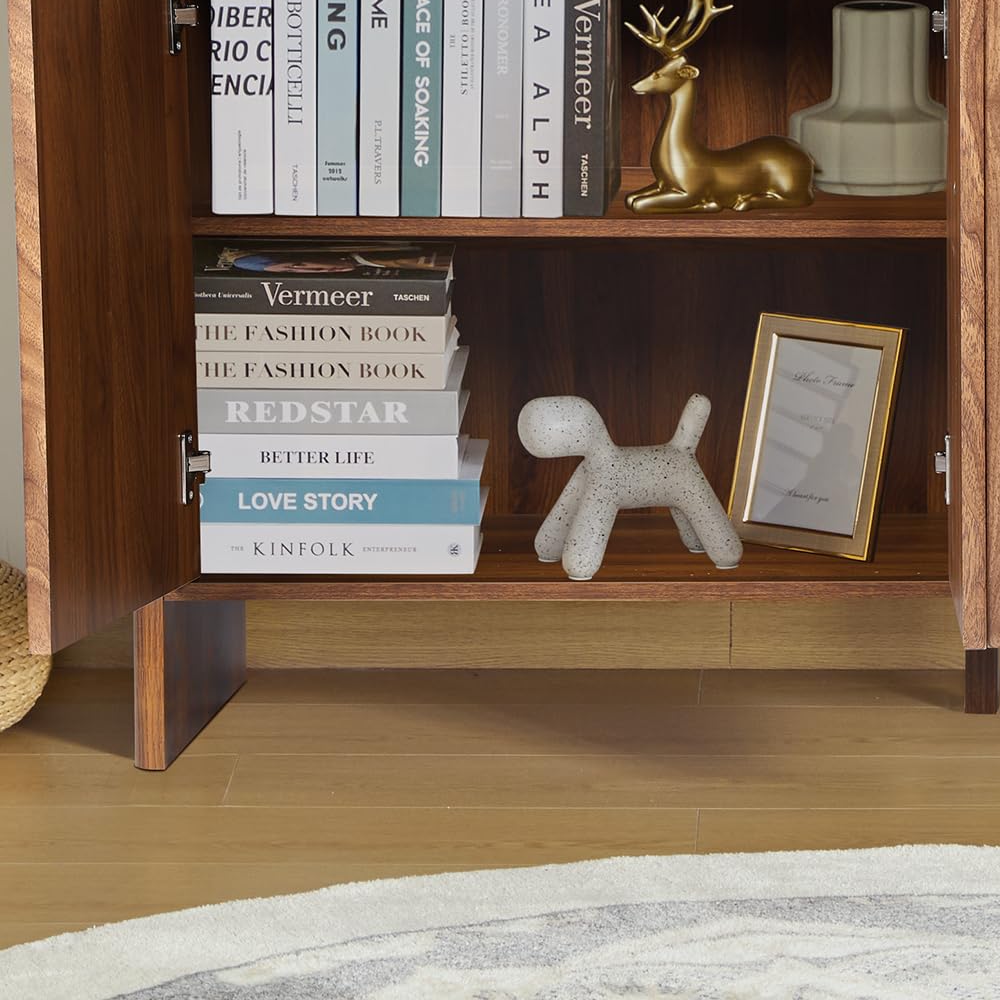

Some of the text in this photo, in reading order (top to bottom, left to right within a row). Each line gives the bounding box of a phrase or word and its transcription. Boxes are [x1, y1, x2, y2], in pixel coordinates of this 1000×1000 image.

[287, 1, 303, 124] BOTTICELLI
[416, 41, 430, 68] OF
[414, 76, 430, 167] SOAKING
[532, 83, 550, 199] ALPH
[260, 282, 373, 307] Vermeer
[245, 325, 351, 341] FASHION
[360, 325, 426, 342] BOOK
[196, 362, 426, 379] HE FASHION BOOK
[225, 400, 409, 424] REDSTAR
[260, 451, 375, 465] BETTER LIFE
[238, 493, 377, 511] LOVE STORY
[254, 542, 355, 557] KINFOLK
